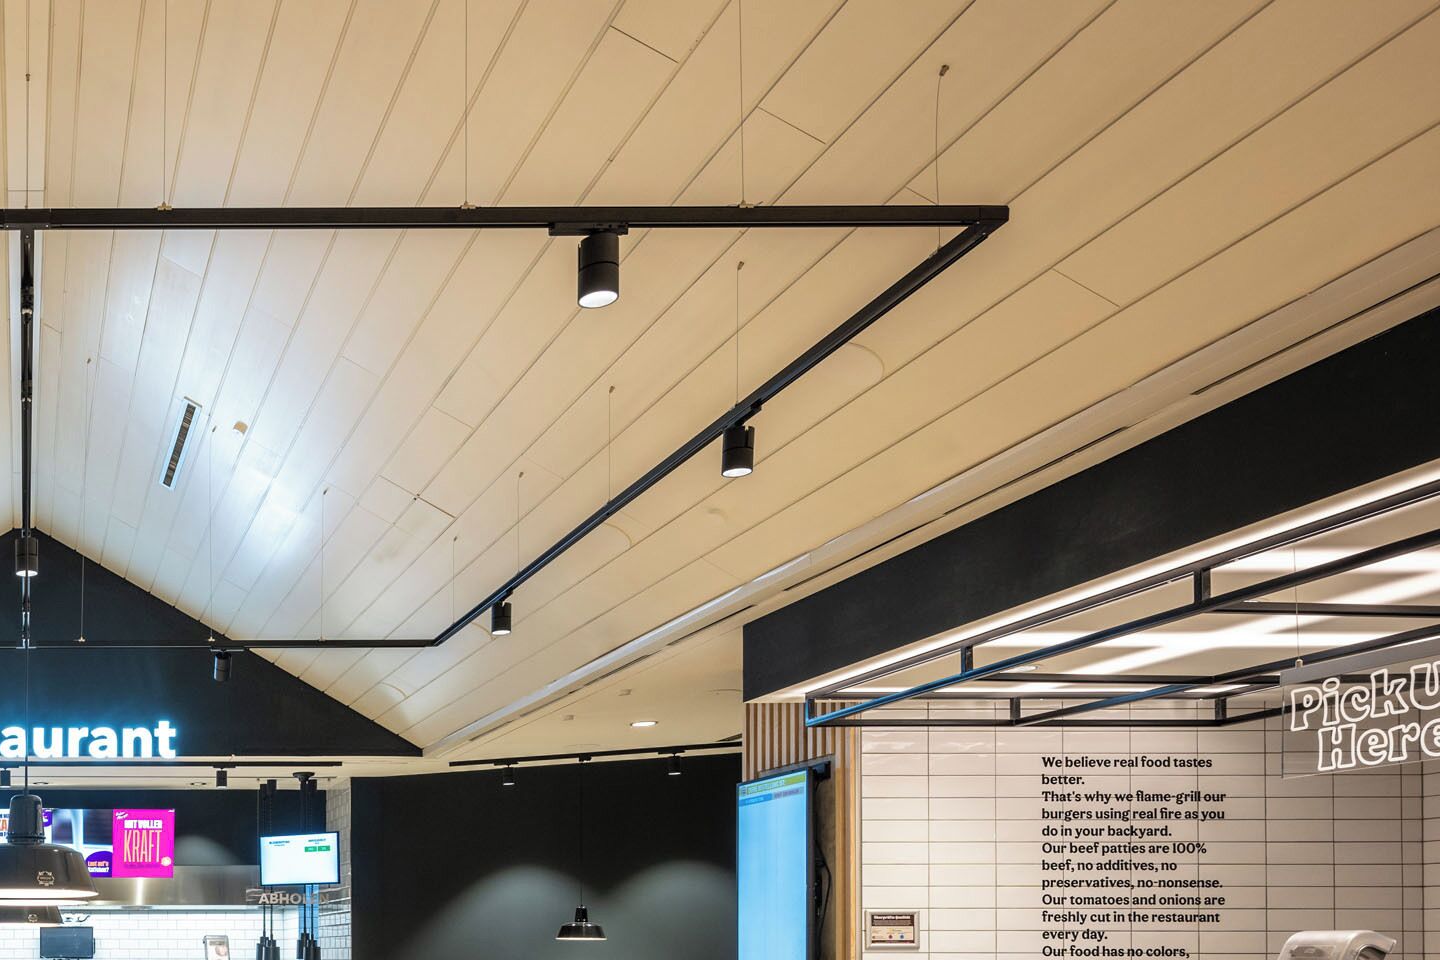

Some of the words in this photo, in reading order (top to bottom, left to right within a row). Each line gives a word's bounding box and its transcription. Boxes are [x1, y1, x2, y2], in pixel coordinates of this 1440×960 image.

[1317, 718, 1440, 772] Here
[1041, 756, 1062, 767] We
[1065, 756, 1111, 767] believe
[1113, 756, 1139, 767] real
[1140, 756, 1171, 767] food
[1173, 756, 1213, 767] tastes
[1041, 773, 1085, 785] better.
[1041, 790, 1082, 802] That's
[1084, 790, 1112, 804] why
[1114, 793, 1134, 802] we
[1135, 790, 1201, 804] flame-grill
[1203, 793, 1227, 802] our
[1041, 808, 1093, 822] burgers
[1095, 808, 1131, 822] using
[1132, 808, 1158, 819] real
[1160, 808, 1182, 819] fire
[1184, 810, 1199, 819] as
[1200, 810, 1225, 822] you
[1041, 825, 1058, 837] do
[1060, 825, 1072, 837] in
[1074, 828, 1105, 839] your
[1107, 825, 1172, 839] backyard.
[124, 830, 162, 862] KRAFT
[1041, 842, 1067, 854] Our
[1069, 842, 1099, 854] beef
[1101, 842, 1146, 856] patties
[1148, 845, 1170, 854] are
[1172, 842, 1207, 854] 100%
[1041, 860, 1075, 873] beef,
[1077, 862, 1094, 871] no
[1095, 860, 1159, 873] additives,
[1160, 862, 1177, 871] no
[1041, 877, 1135, 890] preservatives,
[1137, 879, 1224, 888] no-nonsense.
[1042, 894, 1067, 906] Our
[1069, 894, 1130, 906] tomatoes
[1132, 894, 1157, 906] and
[1158, 894, 1202, 906] onions
[1203, 897, 1226, 906] are
[1042, 911, 1087, 925] freshly
[1089, 911, 1111, 923] cut
[1113, 911, 1125, 923] in
[1127, 911, 1149, 923] the
[1151, 911, 1220, 923] restaurant
[1042, 931, 1079, 942] every
[1081, 929, 1108, 942] day.
[1042, 946, 1067, 957] Our
[1069, 946, 1100, 957] food
[1102, 946, 1125, 957] has
[1127, 948, 1144, 957] no
[1145, 946, 1190, 959] colors,
